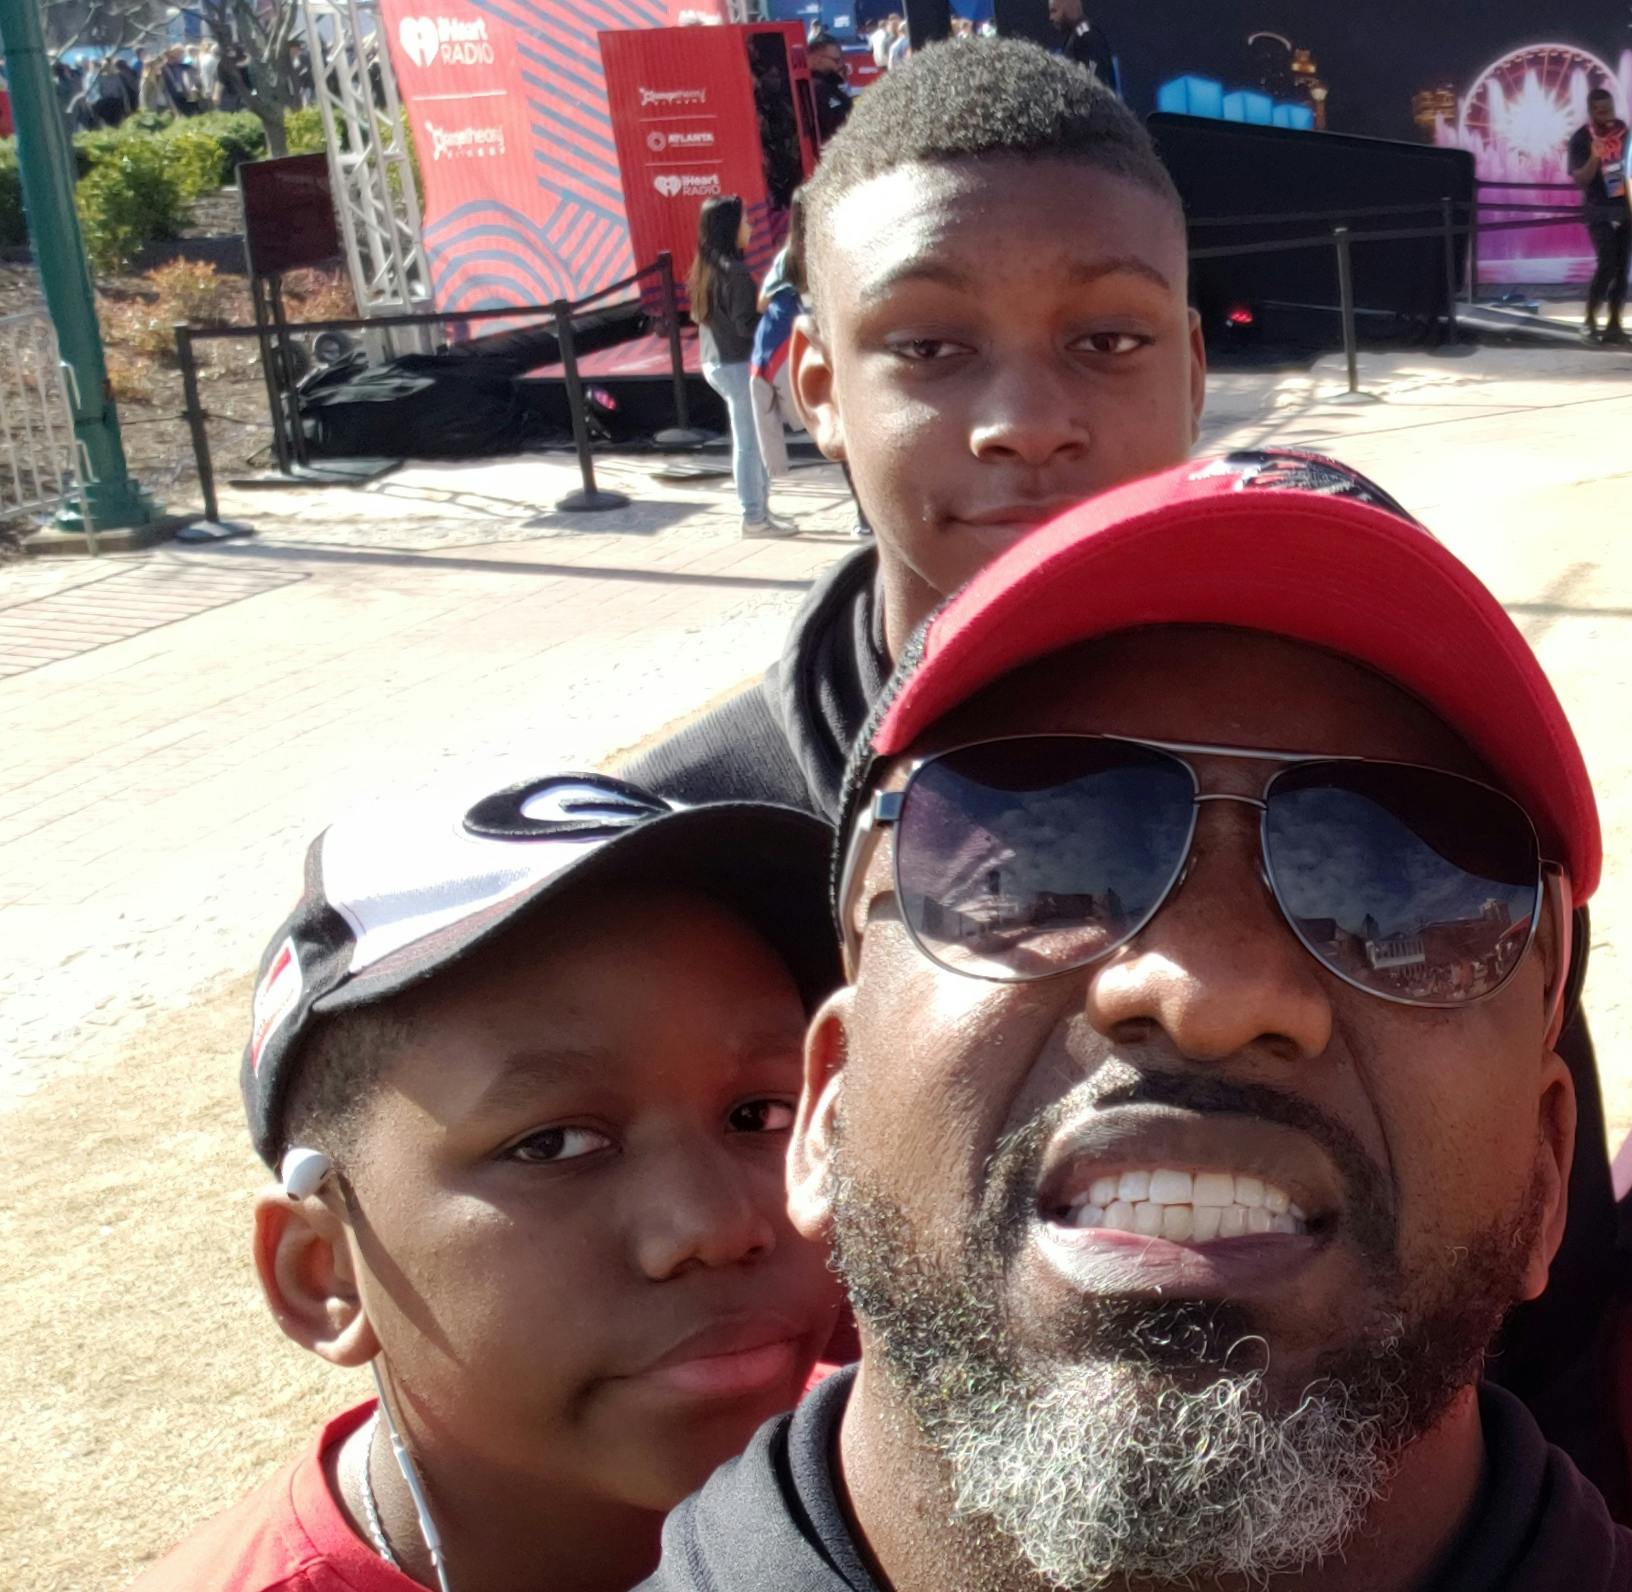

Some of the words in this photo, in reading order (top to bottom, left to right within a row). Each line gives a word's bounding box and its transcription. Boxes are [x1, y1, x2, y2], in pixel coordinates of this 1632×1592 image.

[441, 41, 494, 65] RADIO
[668, 132, 714, 144] ATLANTA
[682, 185, 721, 196] RADIO
[462, 771, 673, 843] G
